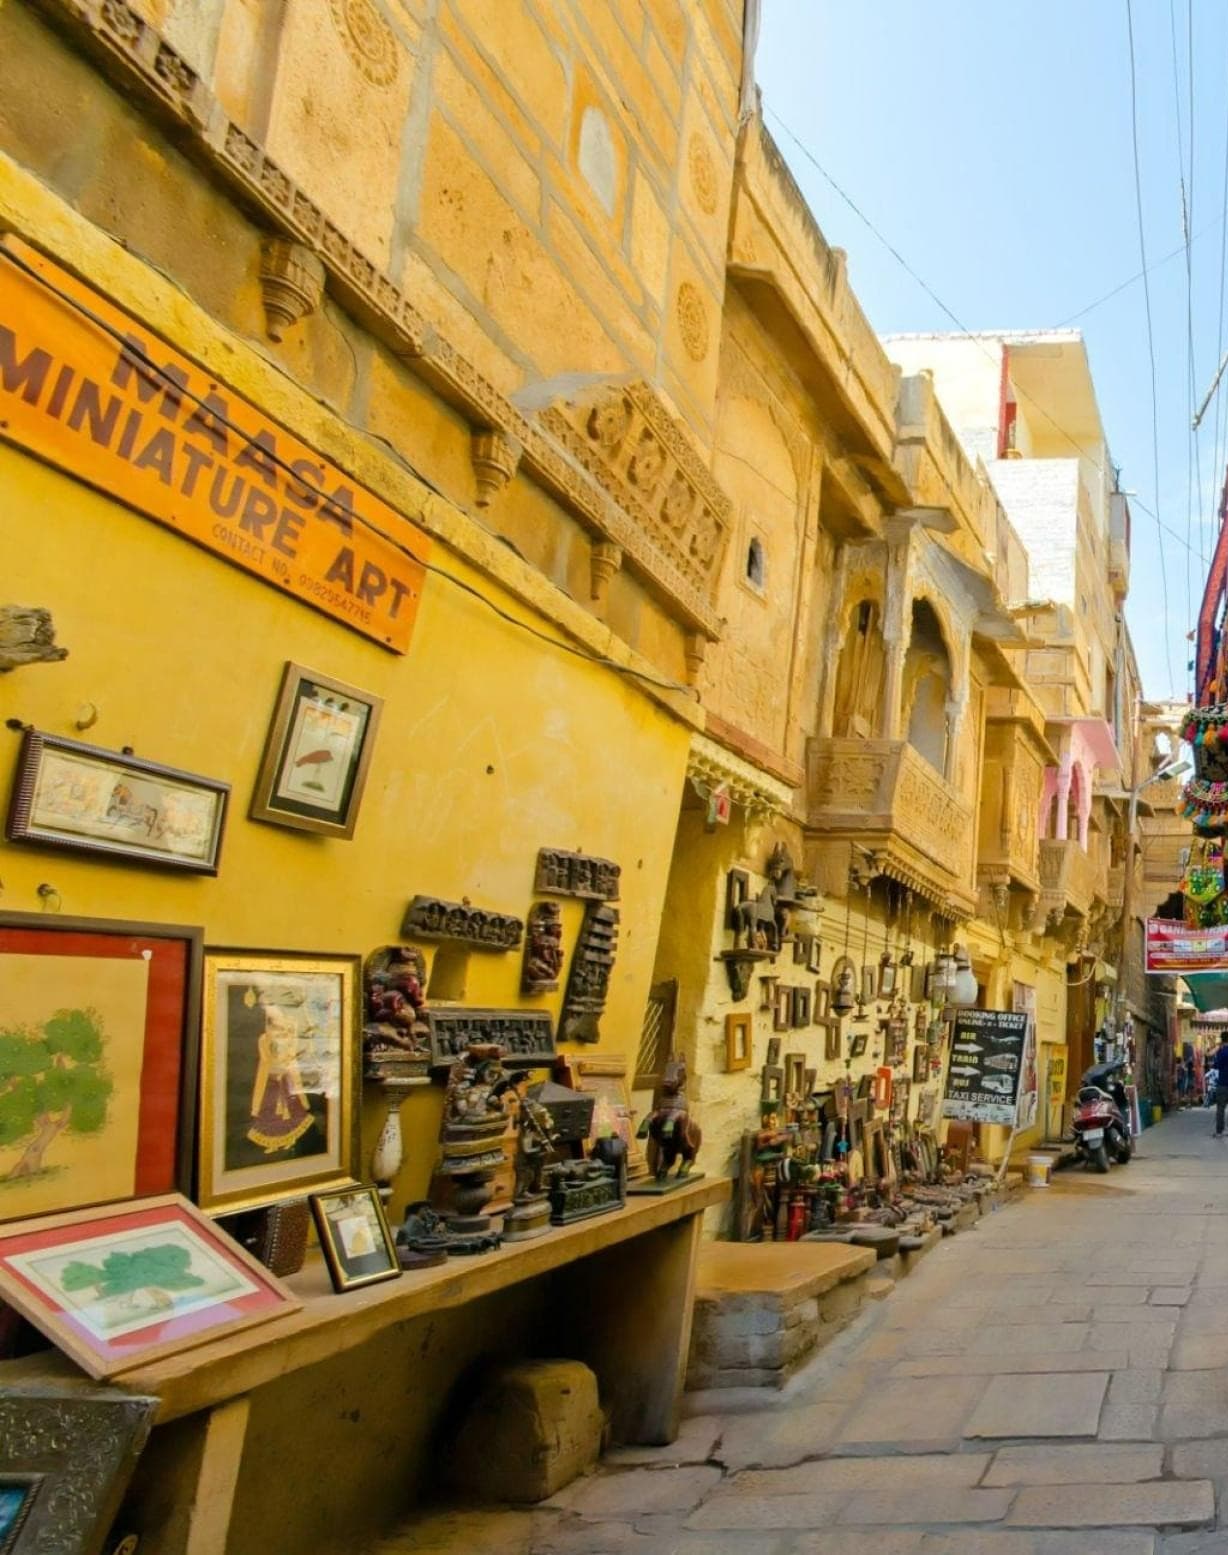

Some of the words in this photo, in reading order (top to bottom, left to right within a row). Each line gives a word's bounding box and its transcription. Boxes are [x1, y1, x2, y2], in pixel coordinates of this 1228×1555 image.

[110, 332, 357, 539] MAASA
[0, 324, 306, 560] MINIATURE
[323, 547, 411, 619] ART
[212, 522, 266, 565] CONTACT
[997, 1013, 1025, 1022] OFFICE
[960, 1031, 977, 1041] AIR
[948, 1090, 969, 1100] TAXI
[970, 1092, 1013, 1104] SERVICE
